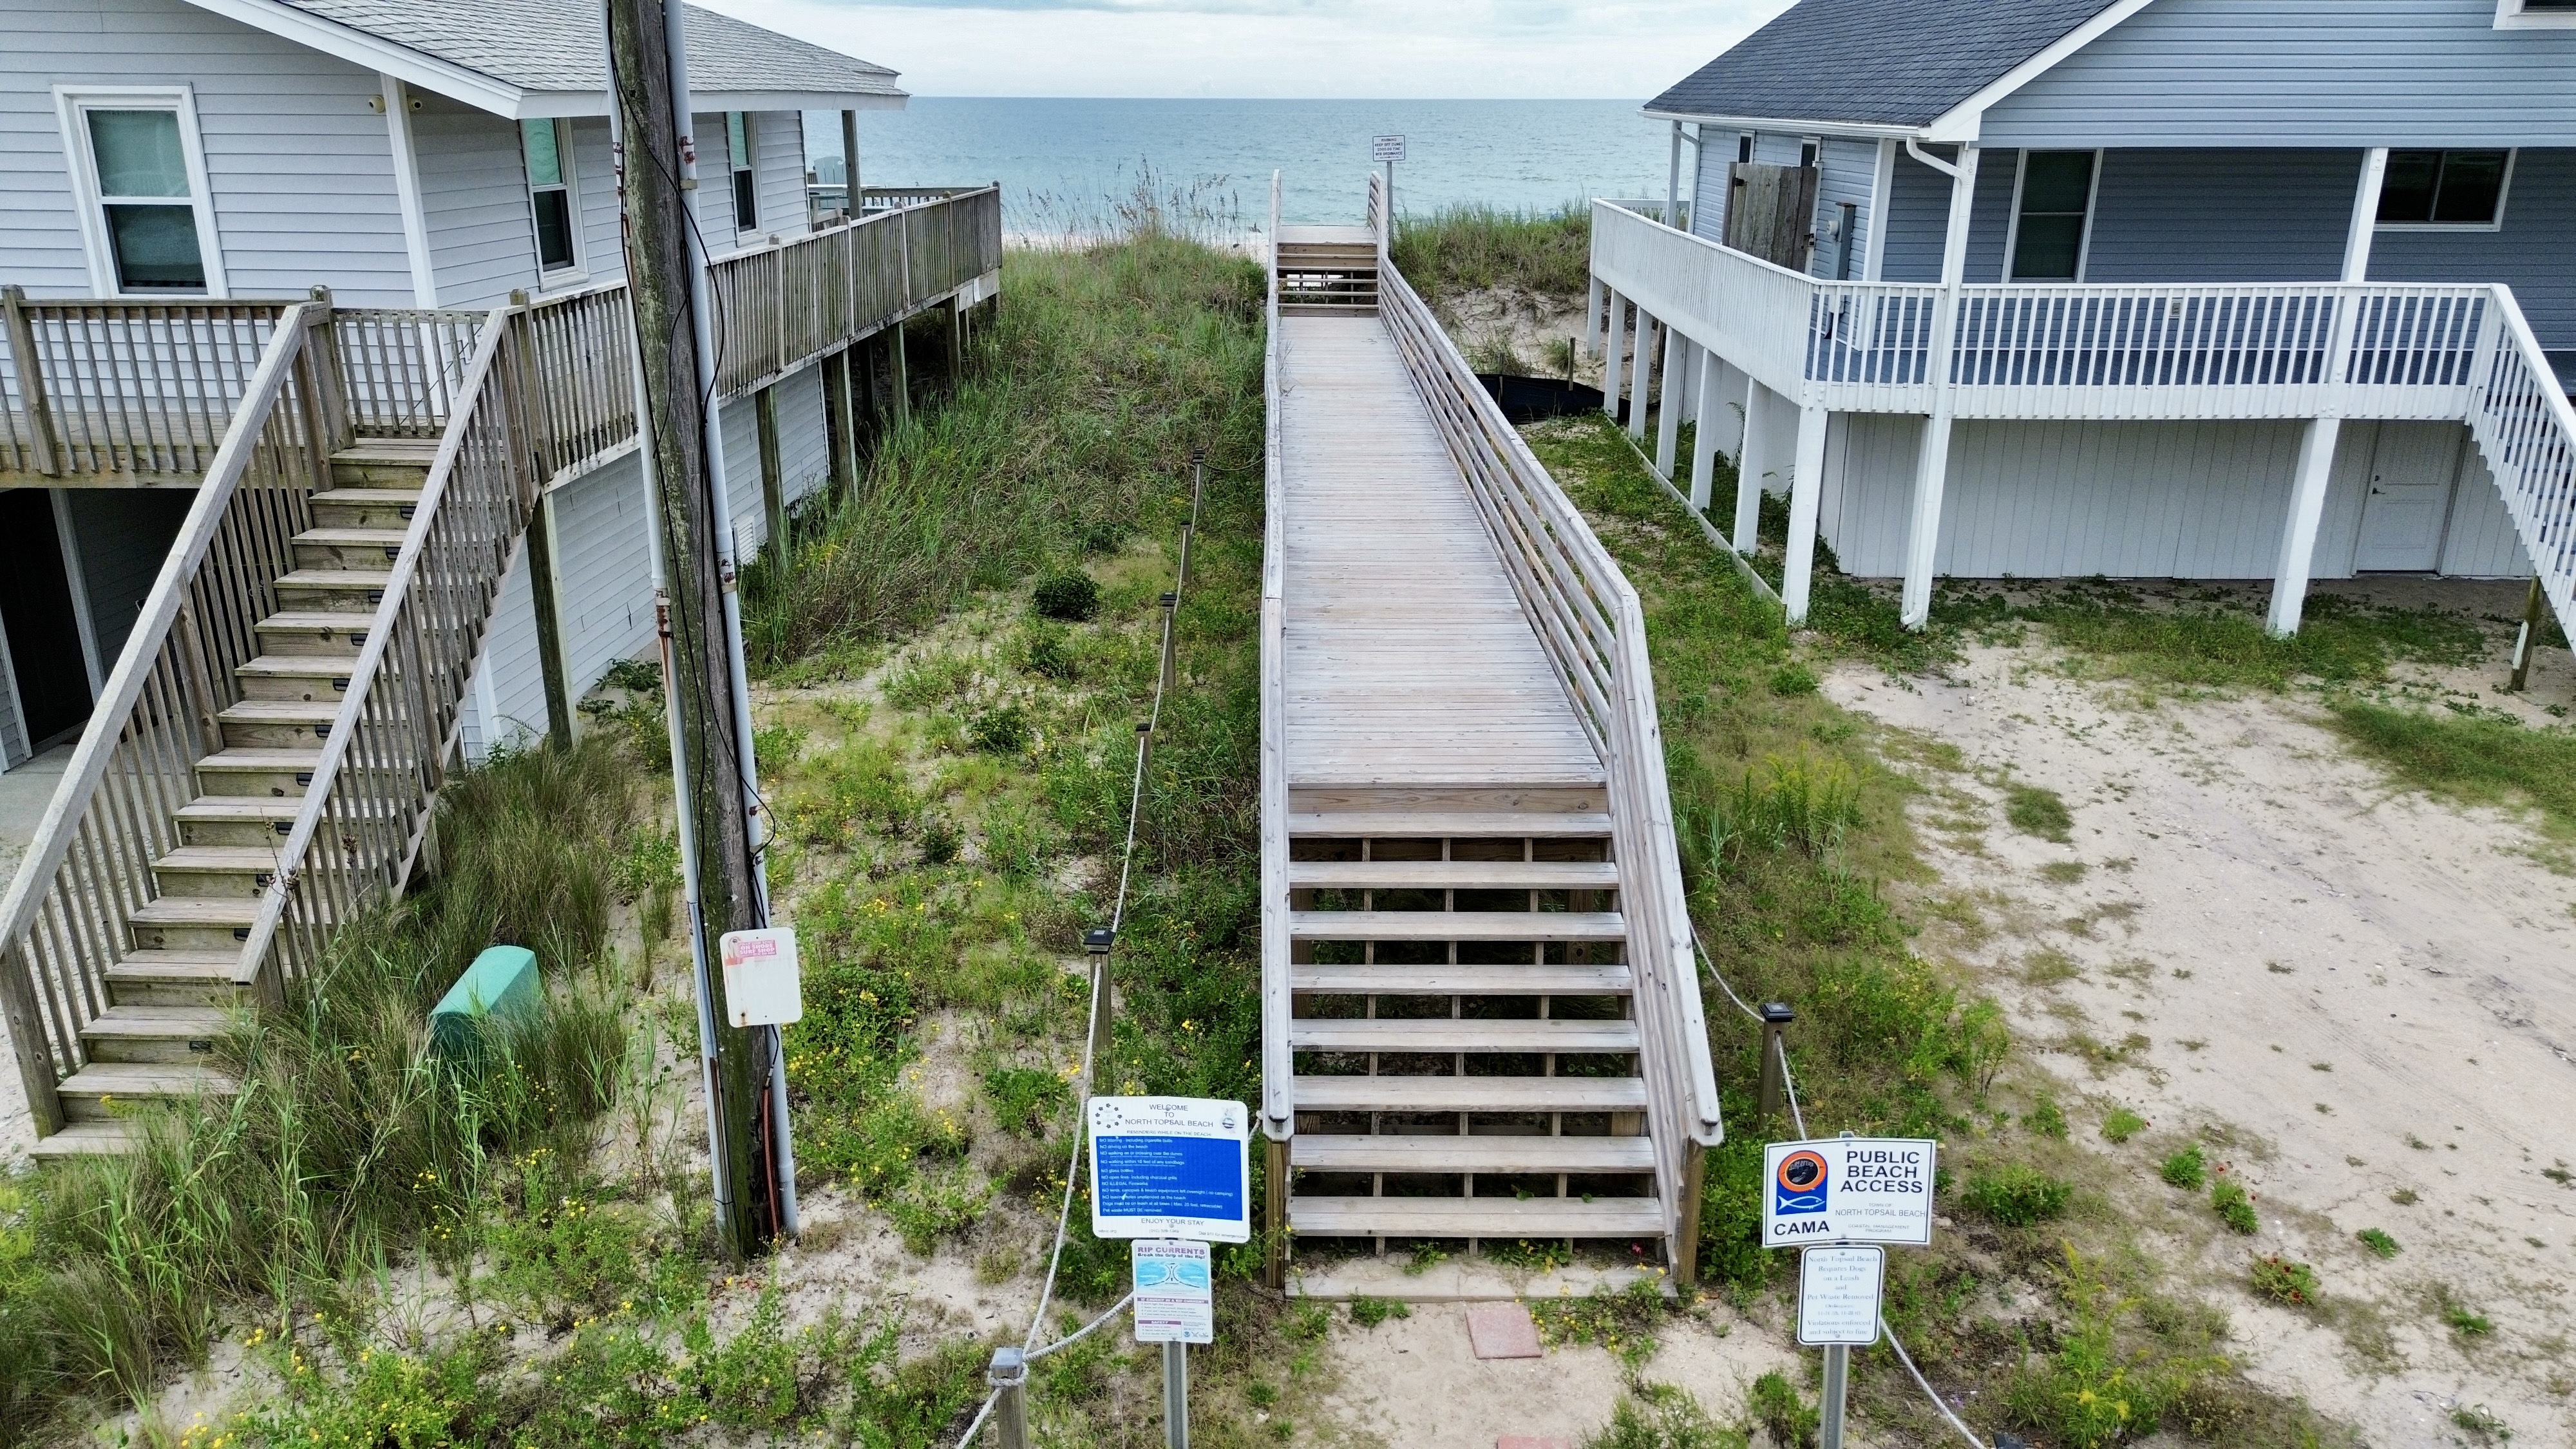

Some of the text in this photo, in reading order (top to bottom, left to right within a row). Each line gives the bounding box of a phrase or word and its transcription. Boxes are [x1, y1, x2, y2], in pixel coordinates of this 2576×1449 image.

[1846, 1150, 1920, 1164] PUBLIC
[1847, 1166, 1917, 1178] BEACH
[1840, 1180, 1922, 1193] ACCESS
[1774, 1220, 1830, 1236] CAMA
